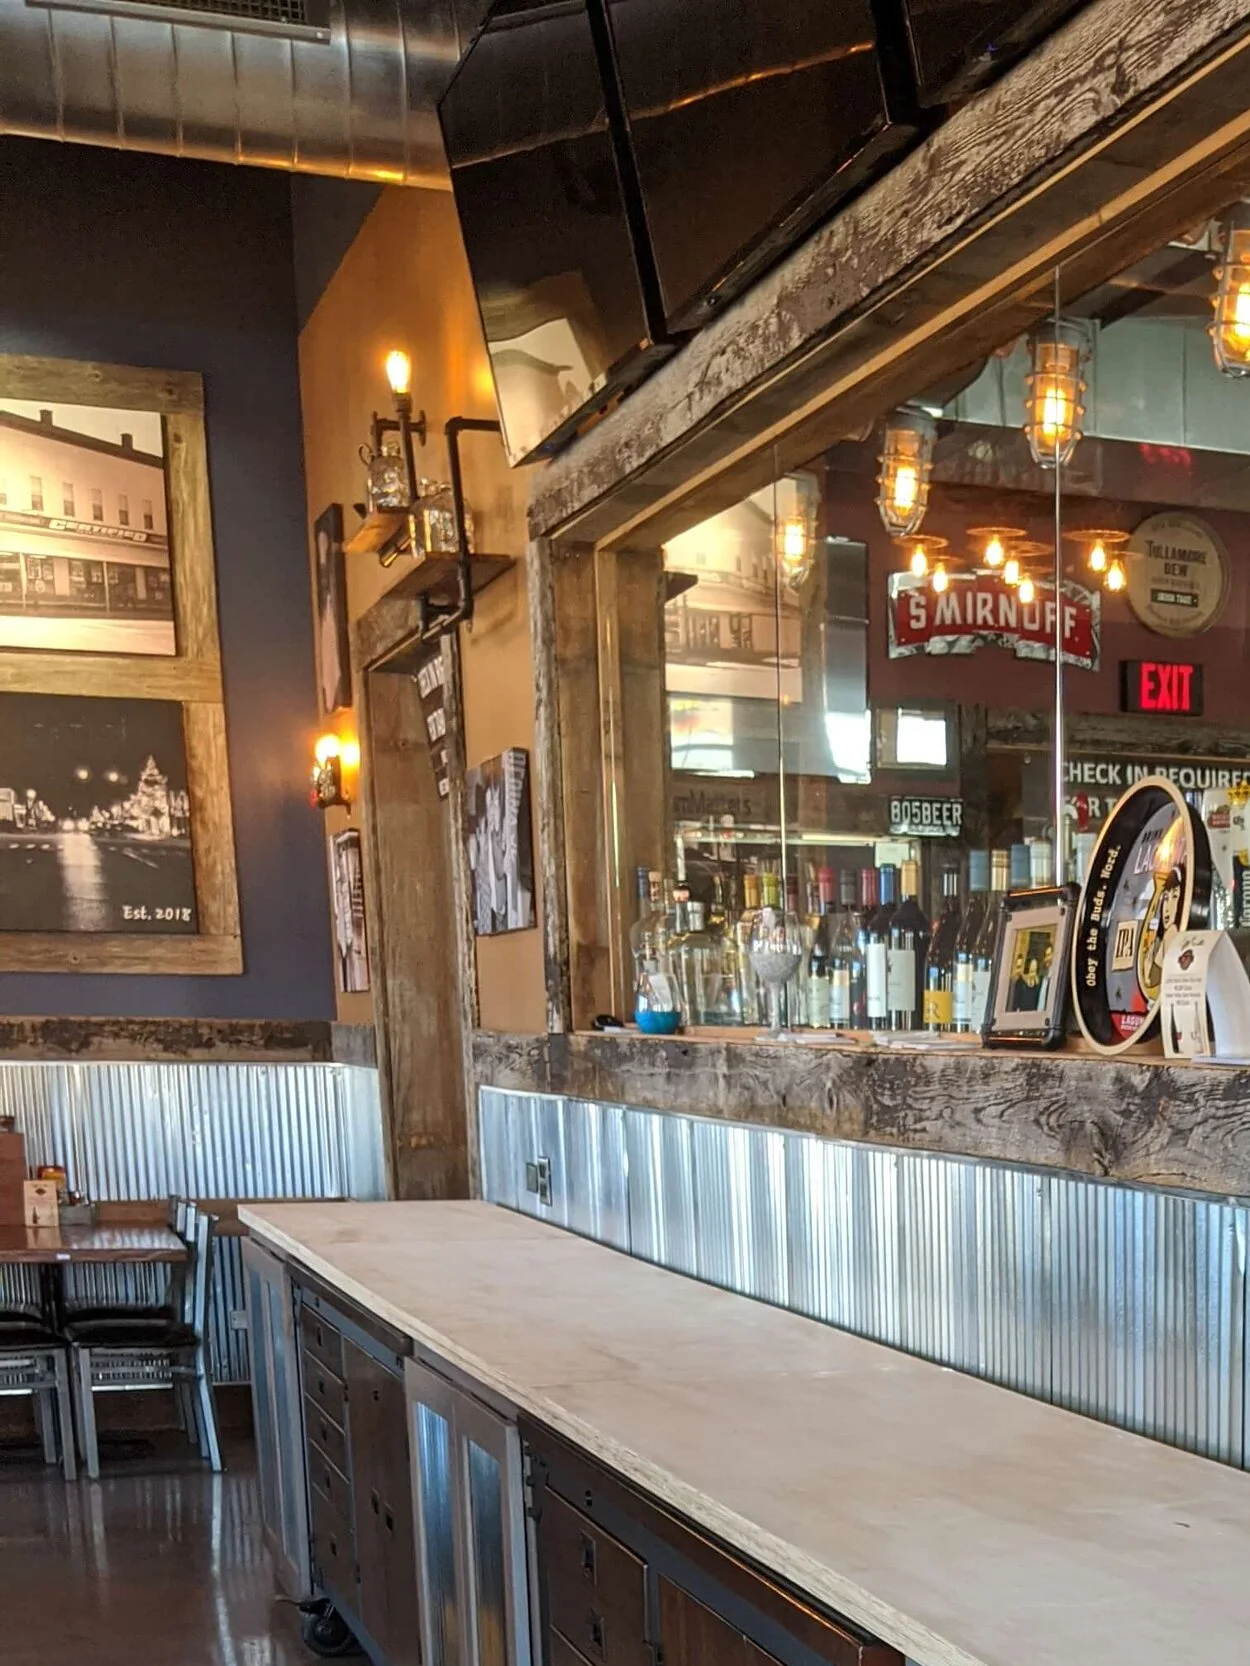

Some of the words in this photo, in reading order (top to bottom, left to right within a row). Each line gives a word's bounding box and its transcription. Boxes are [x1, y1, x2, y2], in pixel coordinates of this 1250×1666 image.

[909, 591, 1077, 638] SMIRNOFF
[1139, 662, 1194, 712] EXIT
[1061, 760, 1122, 785] CHECK
[1127, 763, 1149, 785] IN
[890, 800, 963, 826] 805BEER
[122, 904, 152, 920] Est.
[155, 907, 192, 922] 2018
[1091, 885, 1108, 922] Buds.
[1087, 928, 1099, 952] the
[1116, 926, 1135, 959] IPA
[1086, 957, 1099, 988] Obey
